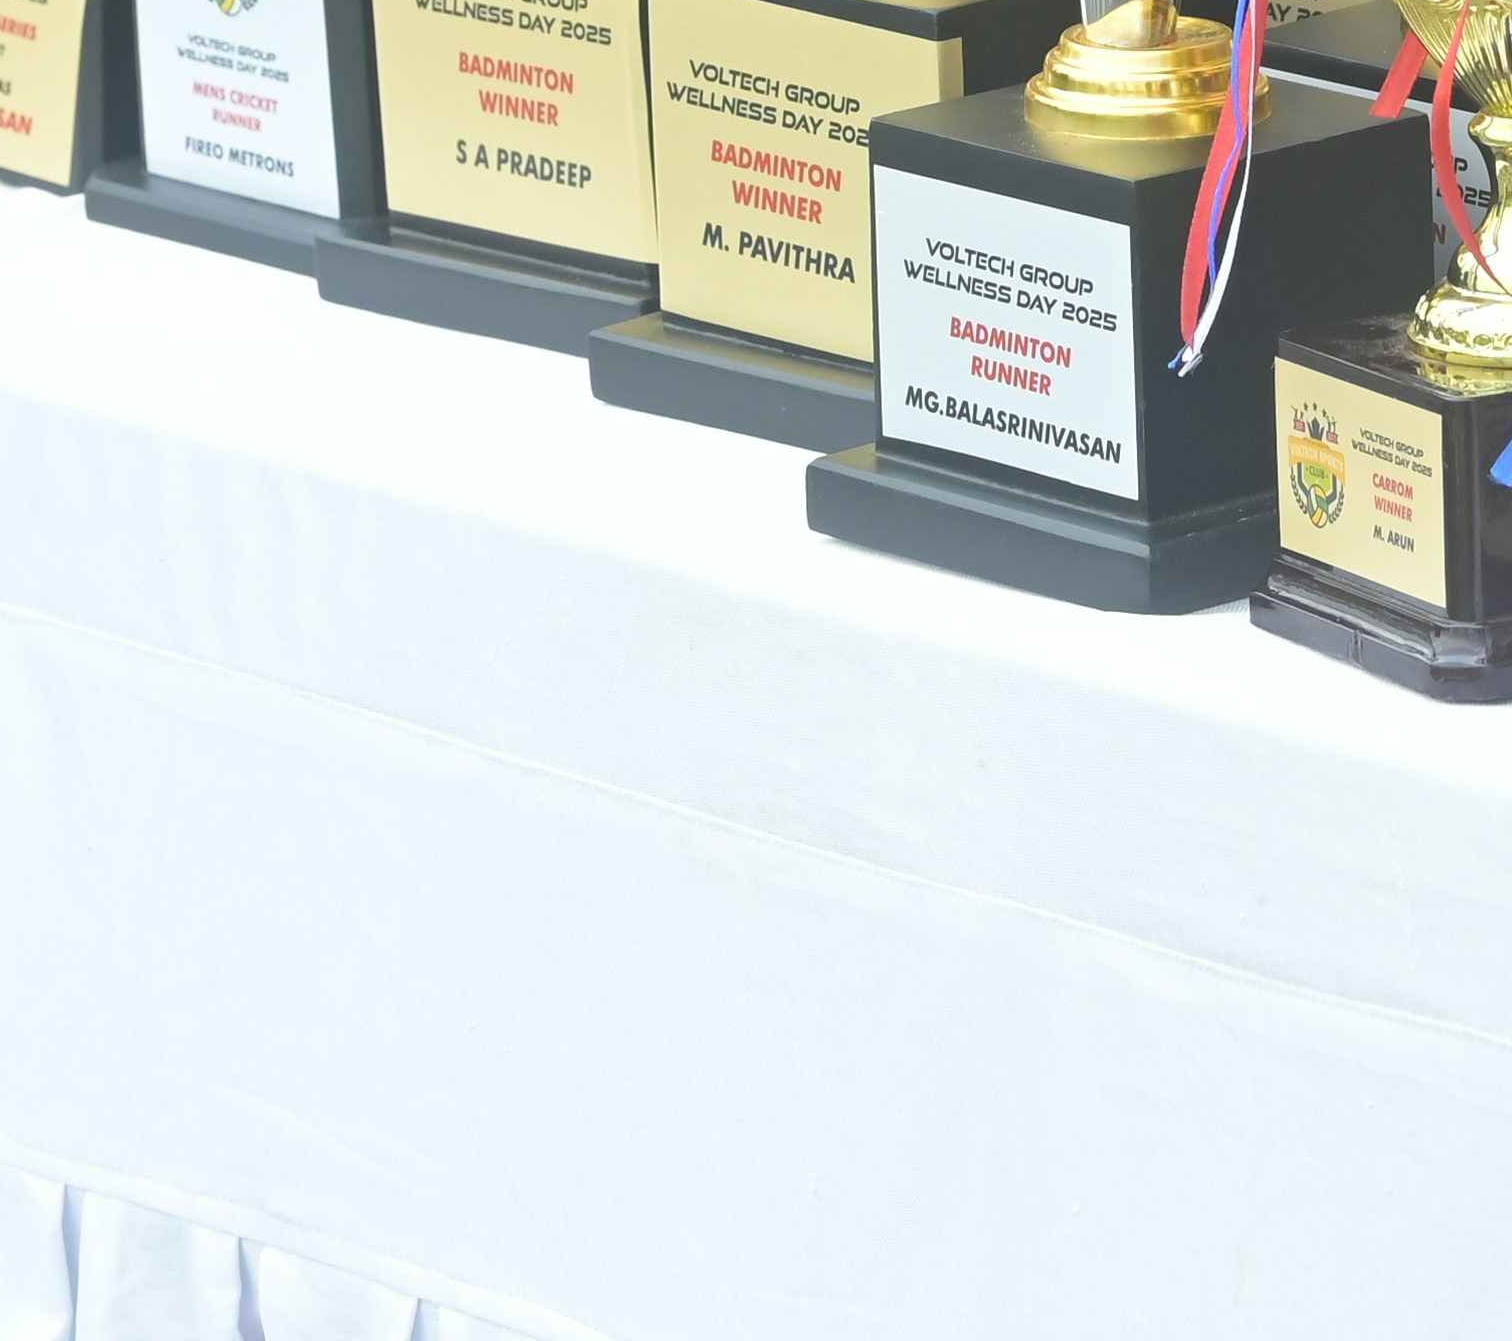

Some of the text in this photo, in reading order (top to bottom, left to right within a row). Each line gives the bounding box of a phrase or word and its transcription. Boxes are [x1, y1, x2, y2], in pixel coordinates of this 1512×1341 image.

[188, 33, 276, 62] VOLTECH GROUP
[519, 11, 556, 34] DAY
[561, 20, 612, 45] 2025
[177, 46, 289, 83] WELLNESS DAY 2025
[458, 52, 574, 94] BADMINTON
[193, 81, 278, 114] MENS CRICKET
[478, 89, 559, 126] WINNER
[689, 59, 860, 115] VOLTECH GROUP
[212, 108, 262, 132] RUNNER
[667, 81, 777, 124] WELLNESS
[782, 111, 823, 135] DAY
[185, 136, 294, 178] FIREO METRONS
[456, 139, 592, 189] S A PRADEEP
[711, 140, 842, 192] BADMINTON
[732, 180, 822, 224] WINNER
[702, 222, 856, 283] M. PAVITHRA
[926, 238, 1094, 296] VOLTECH GROUP
[903, 259, 1117, 332] WELLNESS DAY 2025
[950, 316, 1072, 368] BADMINTON
[971, 355, 1051, 396] RUNNER
[905, 385, 1121, 464] MG.BALASRINIVASAN
[1359, 428, 1424, 458] VOLTECH GROUP
[1309, 465, 1325, 479] CLUB
[1351, 439, 1432, 478] WELLNESS DAY 2025
[1372, 472, 1413, 501] CARROM
[1374, 495, 1412, 522] WINNER
[1373, 525, 1414, 553] M. ARUN
